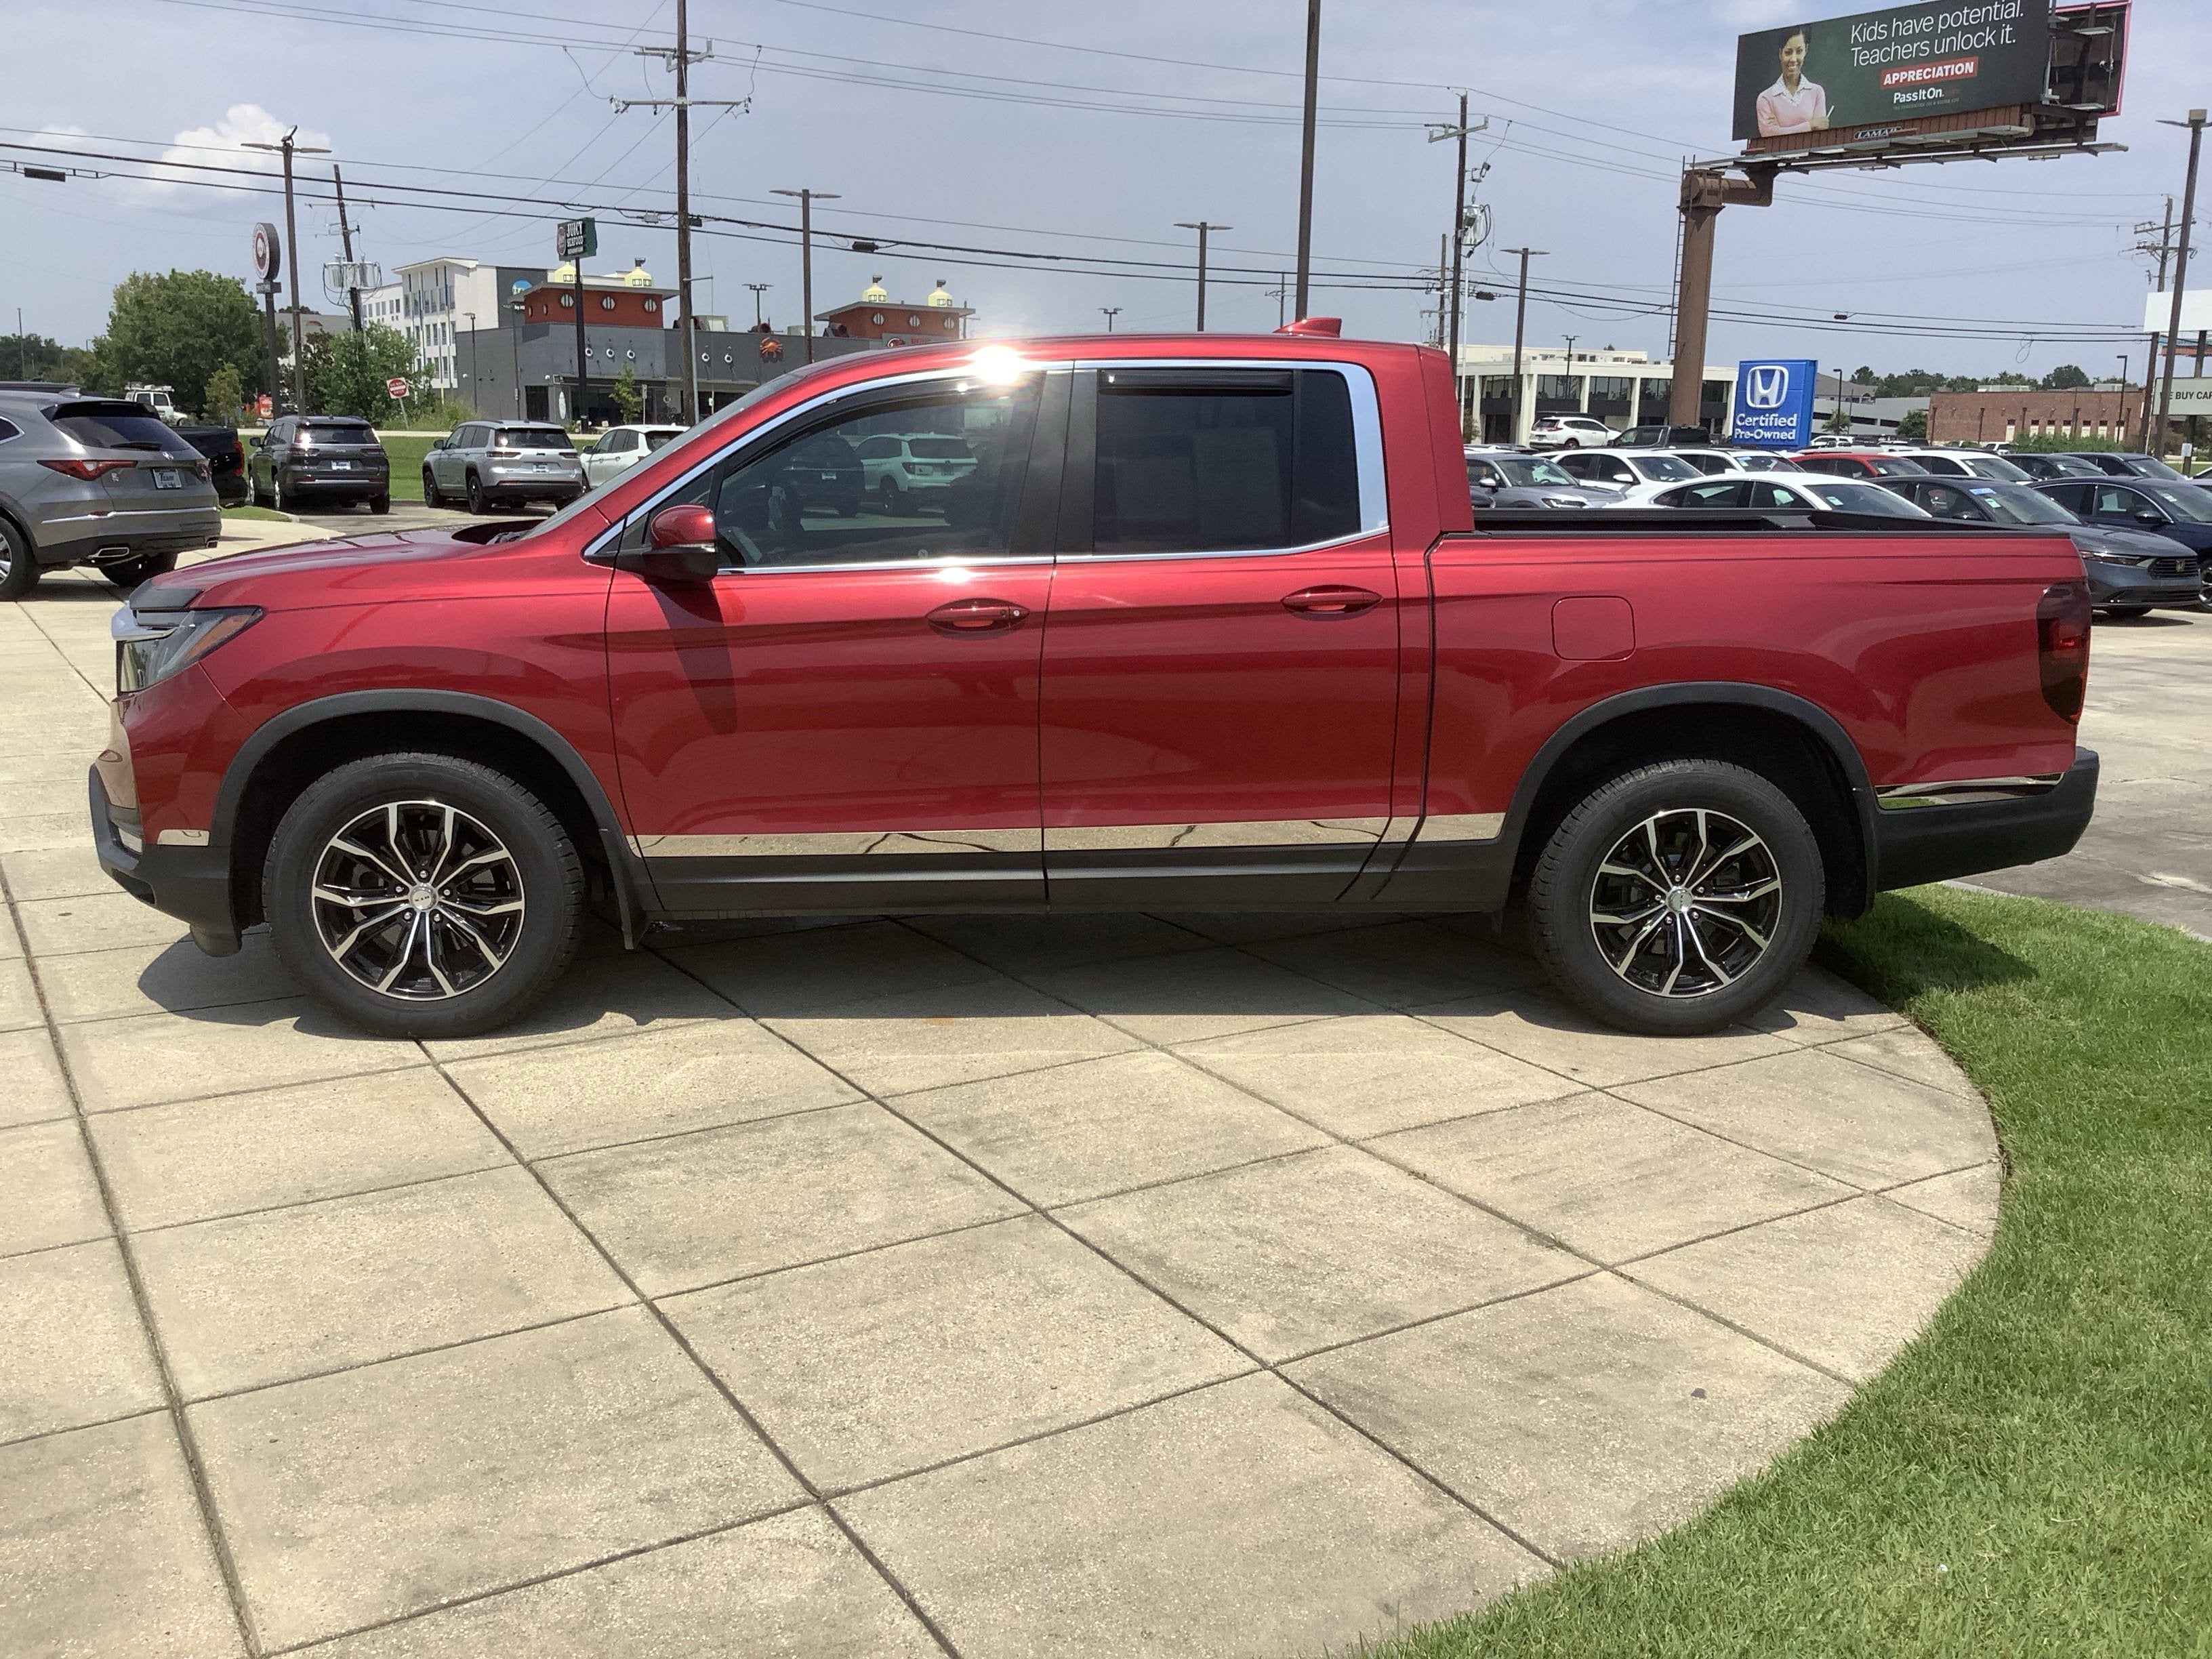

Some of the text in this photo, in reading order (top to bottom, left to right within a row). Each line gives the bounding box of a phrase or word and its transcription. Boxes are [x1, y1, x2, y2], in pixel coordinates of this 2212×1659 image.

[1850, 0, 2024, 44] Kids have potential.
[1850, 24, 2016, 66] Teachers unlock it.
[1883, 62, 1974, 85] APPRECIATION
[567, 221, 583, 238] JUICY
[2175, 391, 2194, 400] BUY
[1736, 413, 1797, 427] Certified
[1734, 429, 1796, 440] Pre-Owned
